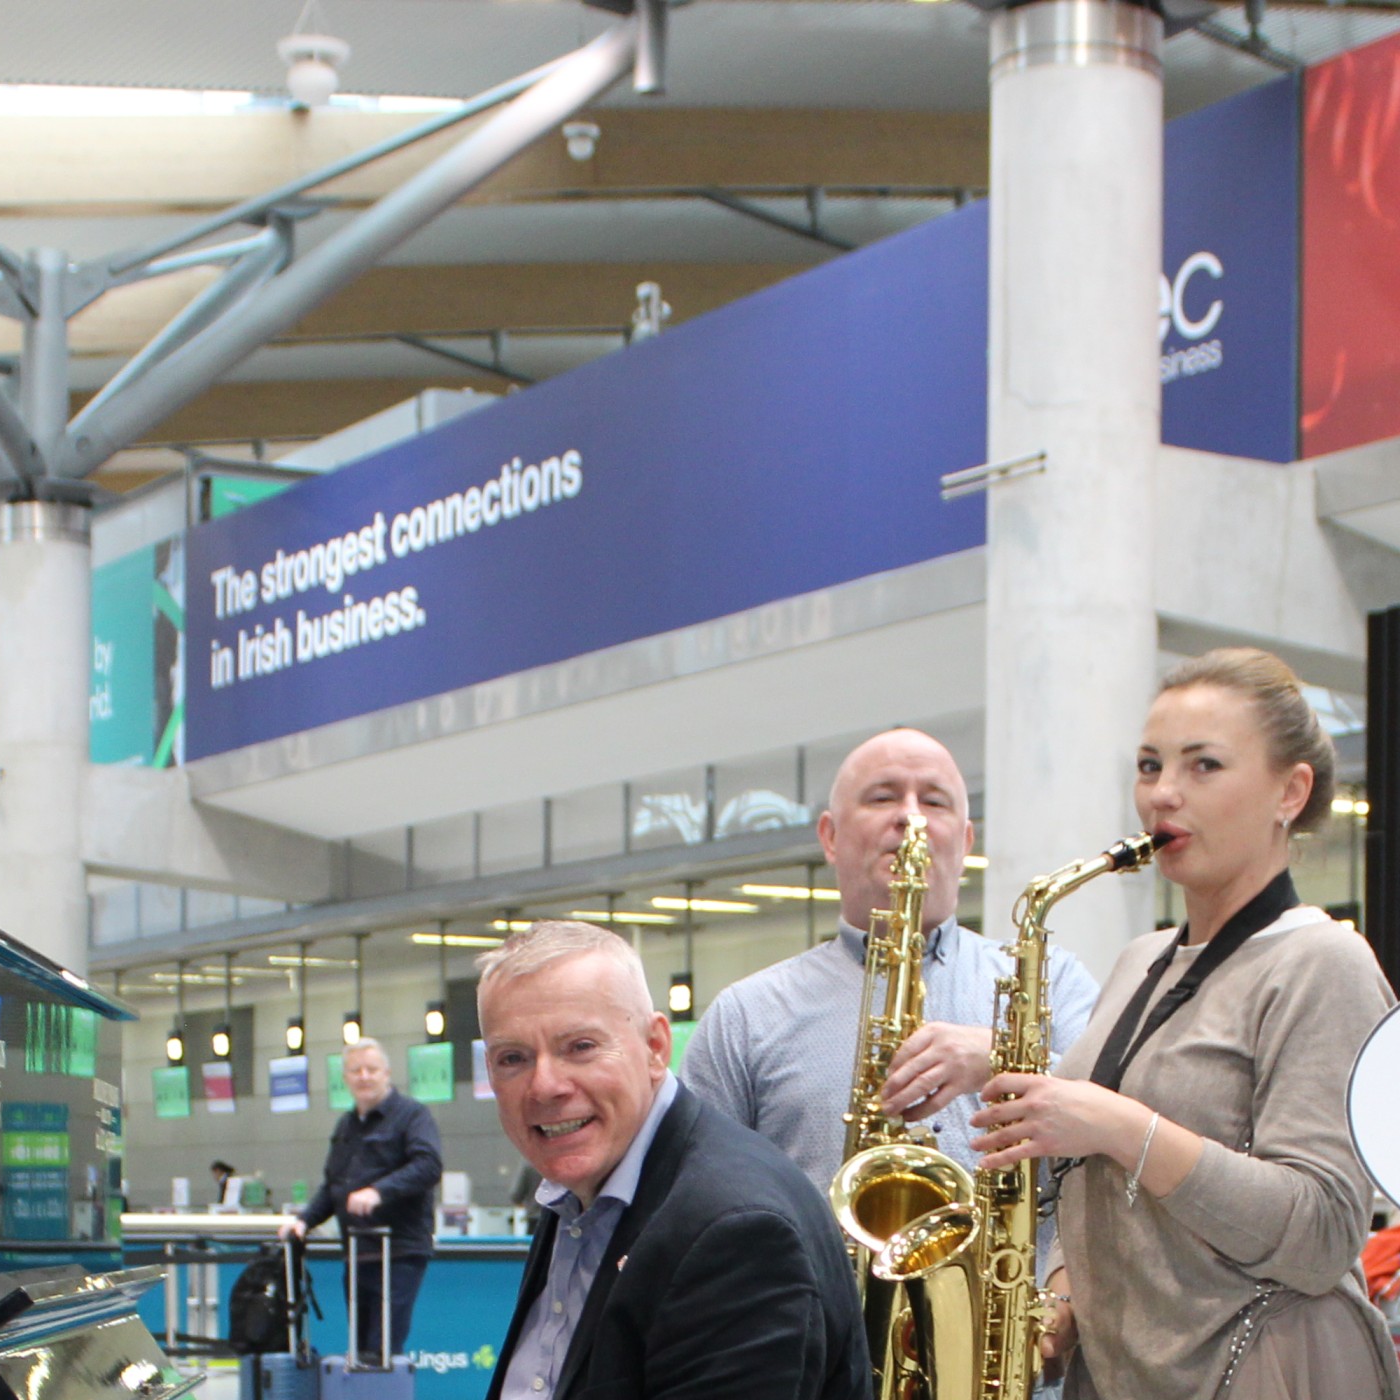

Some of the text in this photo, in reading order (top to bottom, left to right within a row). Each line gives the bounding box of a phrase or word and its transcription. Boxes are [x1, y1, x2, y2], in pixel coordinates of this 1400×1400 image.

[210, 449, 583, 620] The strongest connections
[211, 586, 426, 688] in Irish business.
